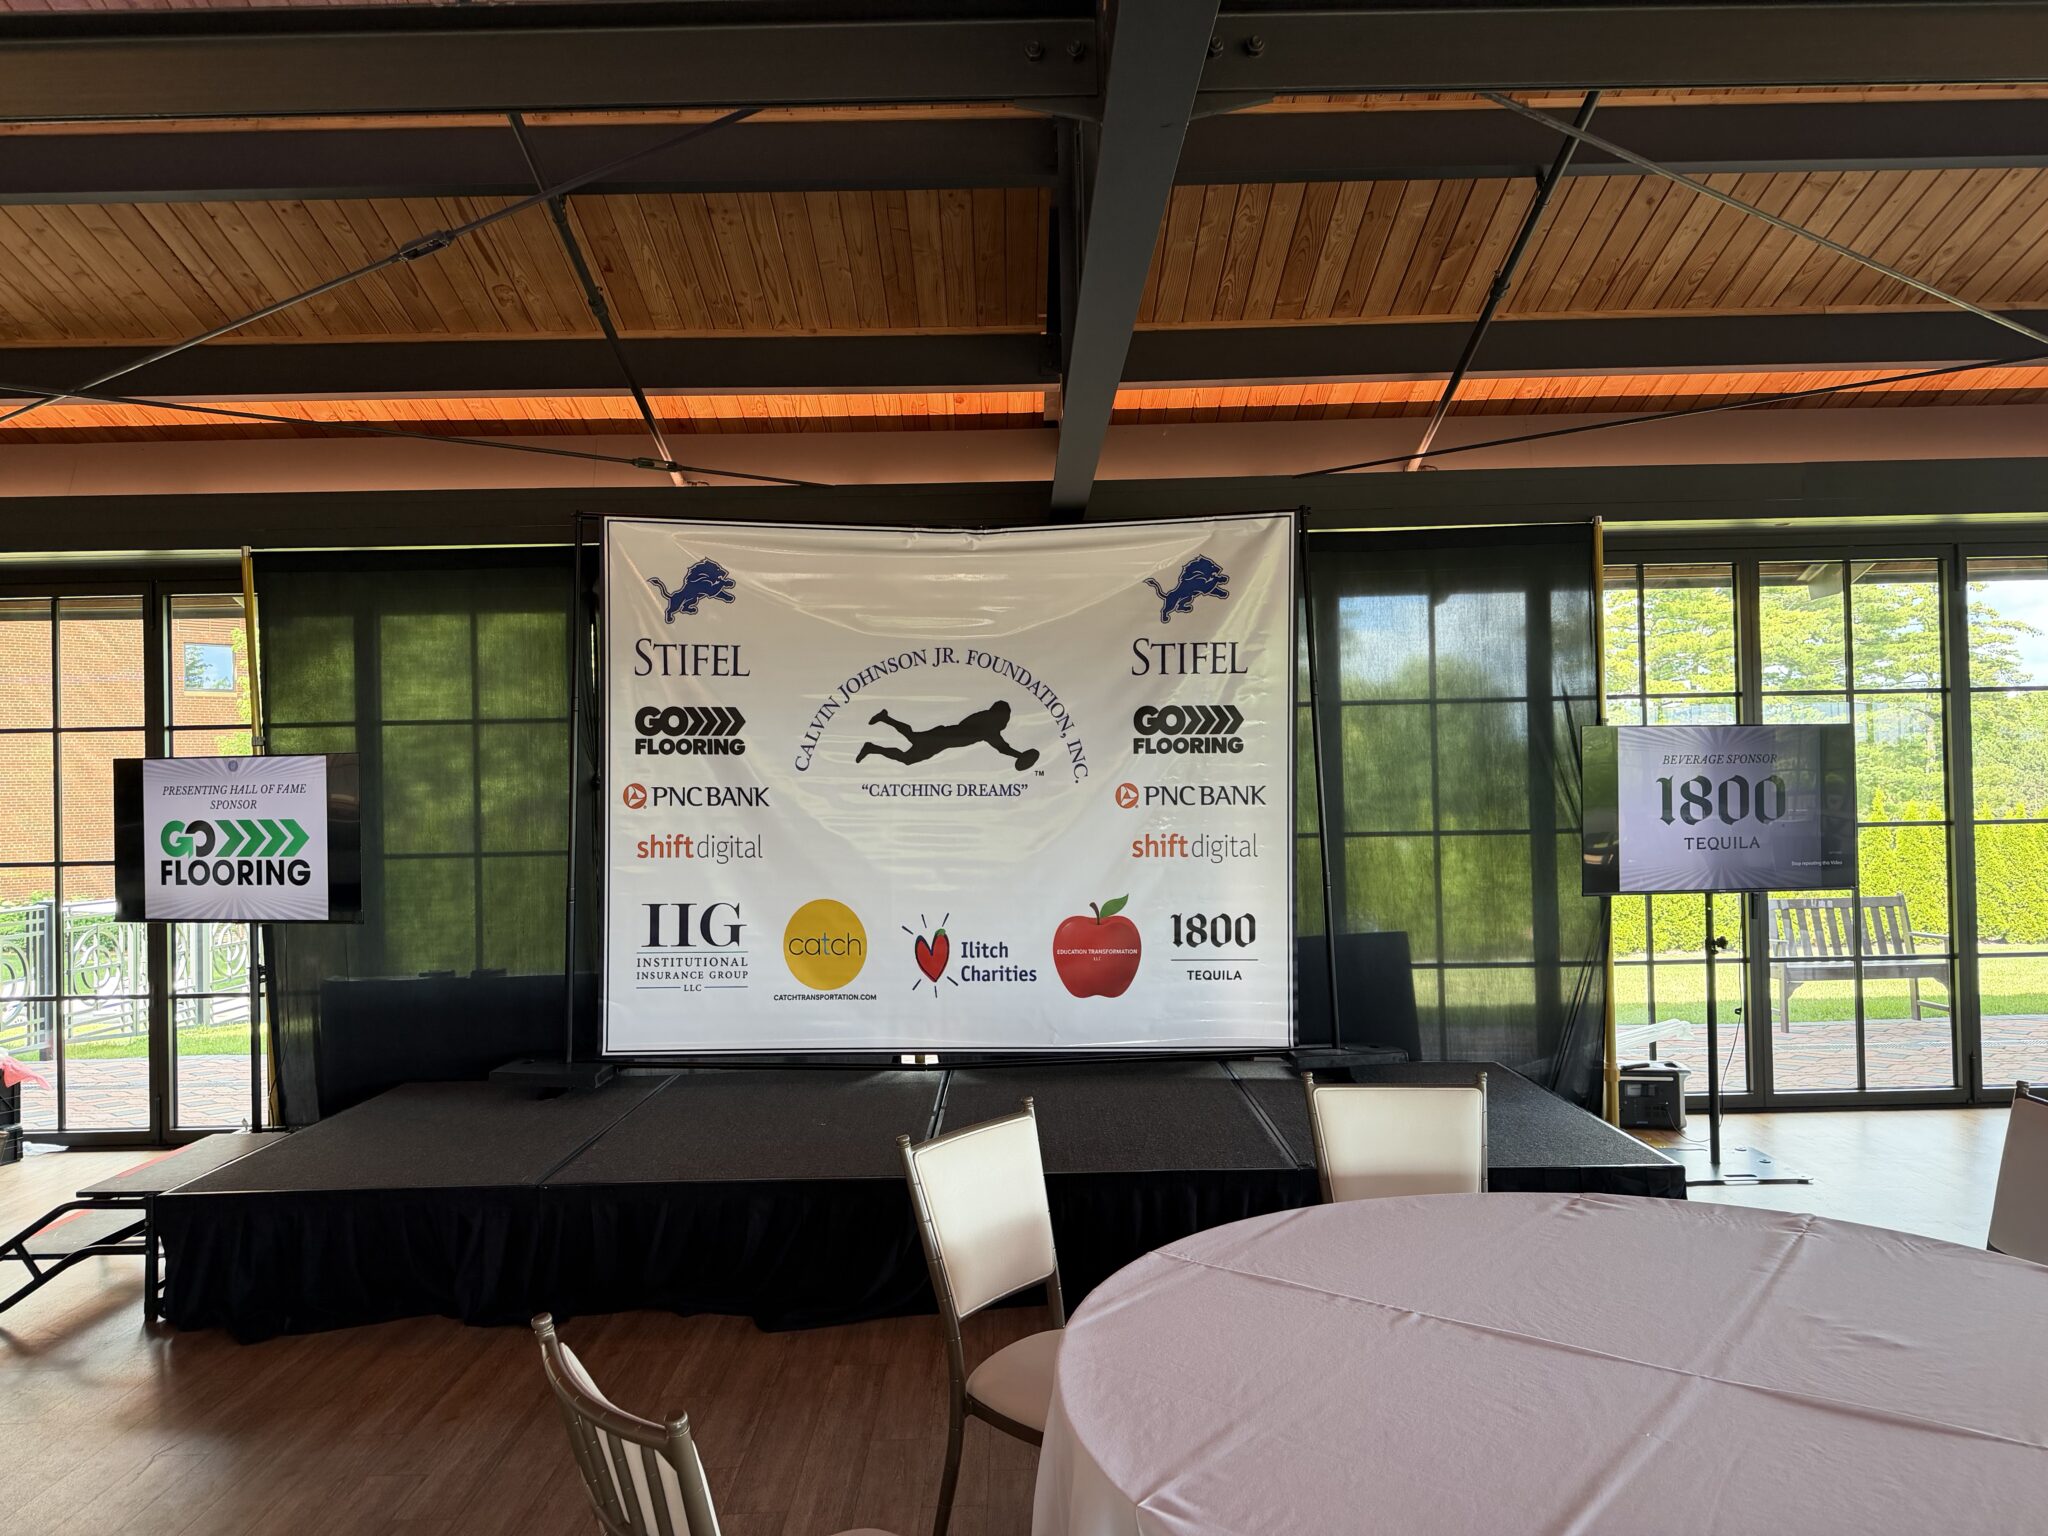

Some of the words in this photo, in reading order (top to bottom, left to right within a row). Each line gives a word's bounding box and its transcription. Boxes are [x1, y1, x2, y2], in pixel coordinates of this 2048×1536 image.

[634, 638, 750, 677] STIFEL
[1131, 638, 1248, 676] STIFEL
[634, 706, 689, 737] GO
[794, 695, 841, 772] CALVIN
[837, 649, 927, 704] JOHNSON
[932, 647, 960, 667] JR.
[966, 649, 1075, 739] FOUNDATION,
[1065, 738, 1089, 784] INC.
[1133, 705, 1186, 736] GO
[635, 738, 746, 756] FLOORING
[1133, 737, 1244, 755] FLOORING
[1662, 754, 1724, 765] BEVERAGE
[1726, 753, 1778, 765] SPONSOR
[162, 785, 228, 796] PRESENTING
[230, 784, 258, 795] HALL
[260, 784, 275, 794] OF
[276, 783, 307, 794] FAME
[651, 785, 703, 807] PNC
[705, 785, 770, 807] BANK
[861, 783, 953, 798] “CATCHING
[957, 783, 1028, 798] DREAMS”
[1144, 785, 1196, 806] PNC
[1199, 785, 1266, 806] BANK
[1655, 774, 1786, 826] 1800
[209, 799, 258, 810] SPONSOR
[161, 820, 216, 859] GO
[636, 833, 694, 859] shift
[696, 834, 763, 864] digital
[1131, 833, 1188, 858] shift
[1190, 833, 1259, 864] digital
[1683, 836, 1760, 851] TEQUILA
[161, 860, 311, 886] FLOORING
[641, 902, 748, 948] IIG
[1170, 912, 1257, 948] 1800
[788, 932, 862, 957] catch
[960, 940, 1009, 959] Ilitch
[636, 956, 748, 968] INSTITUTIONAL
[636, 971, 704, 980] INSURANCE
[708, 970, 749, 980] GROUP
[960, 964, 1037, 982] Charities
[1186, 970, 1243, 981] TEQUILA
[683, 984, 702, 993] LLC
[773, 993, 877, 1001] CATCHTRANSPORTATION.COM
